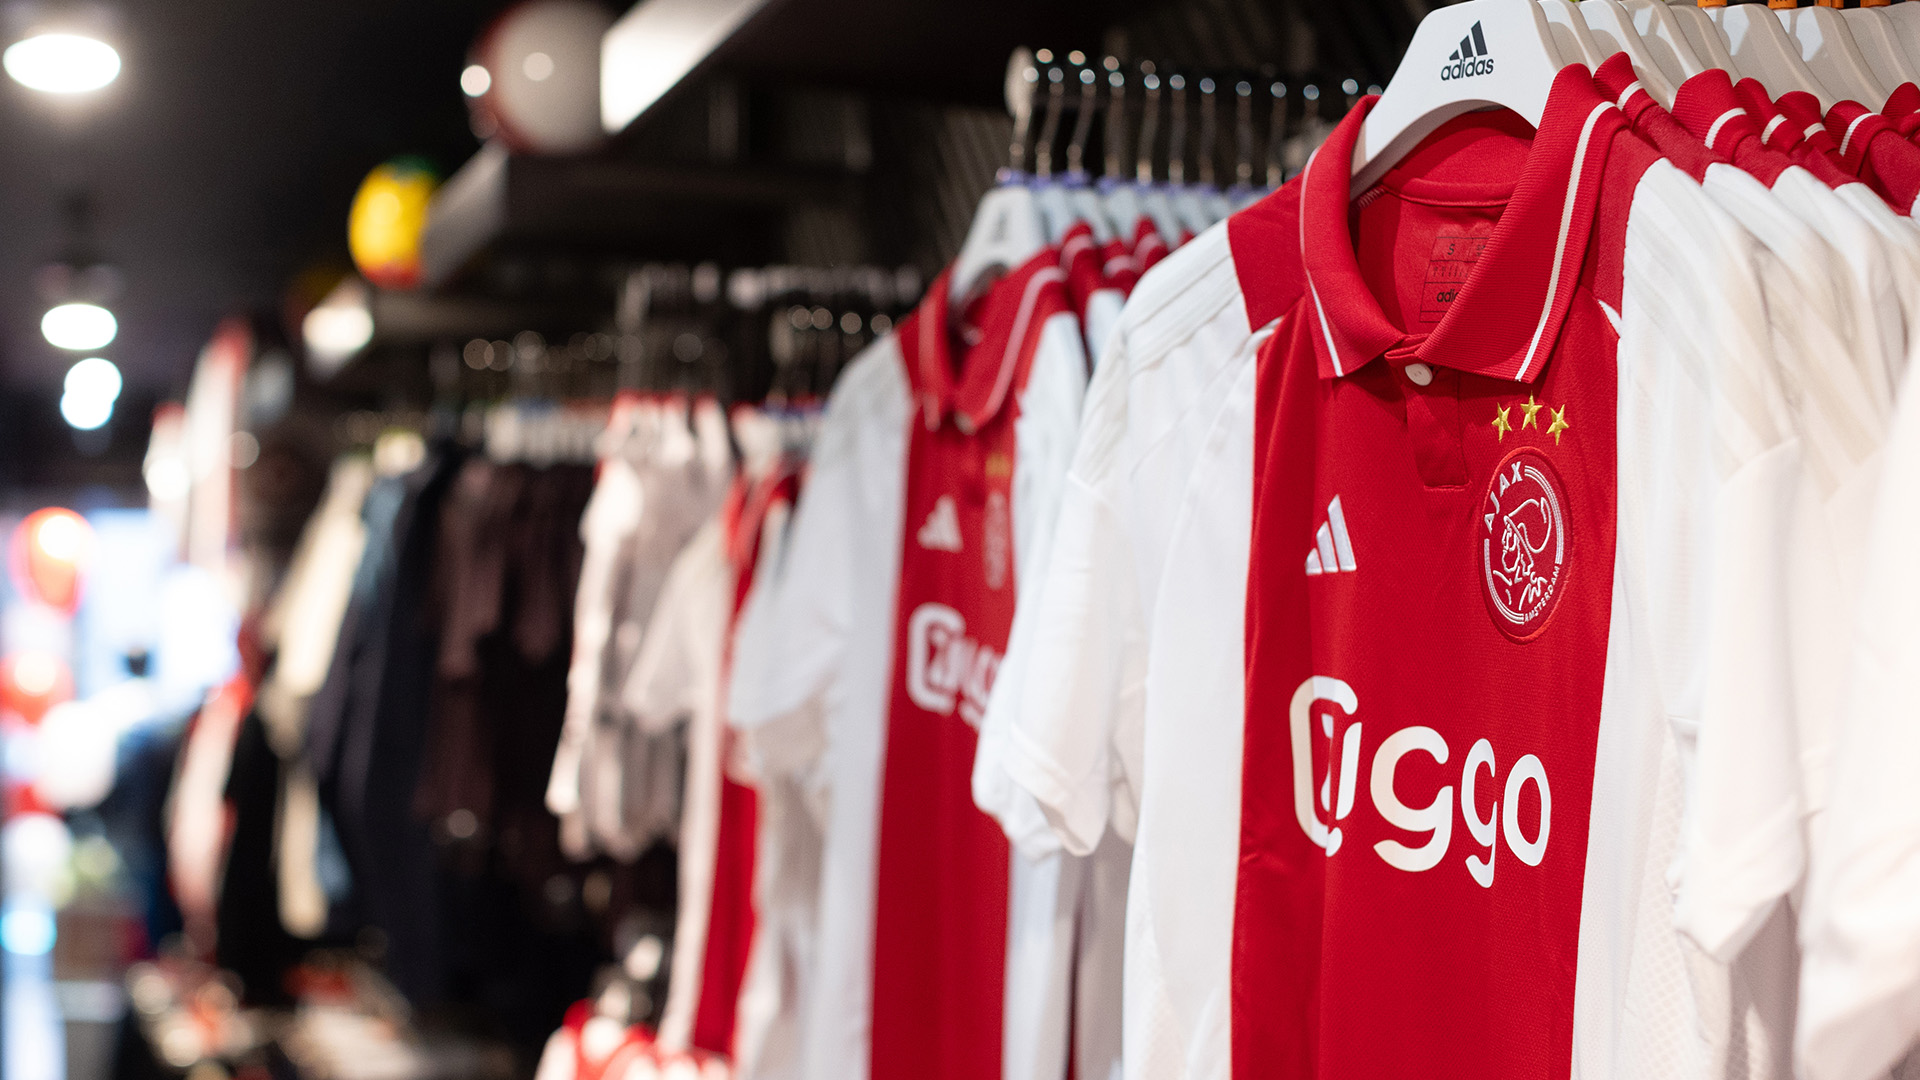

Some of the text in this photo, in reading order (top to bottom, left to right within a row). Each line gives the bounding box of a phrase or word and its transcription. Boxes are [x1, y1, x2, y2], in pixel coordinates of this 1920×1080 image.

[1440, 56, 1495, 82] adidas
[1484, 460, 1523, 534] AJAX
[1524, 565, 1561, 623] AMSTERDAM
